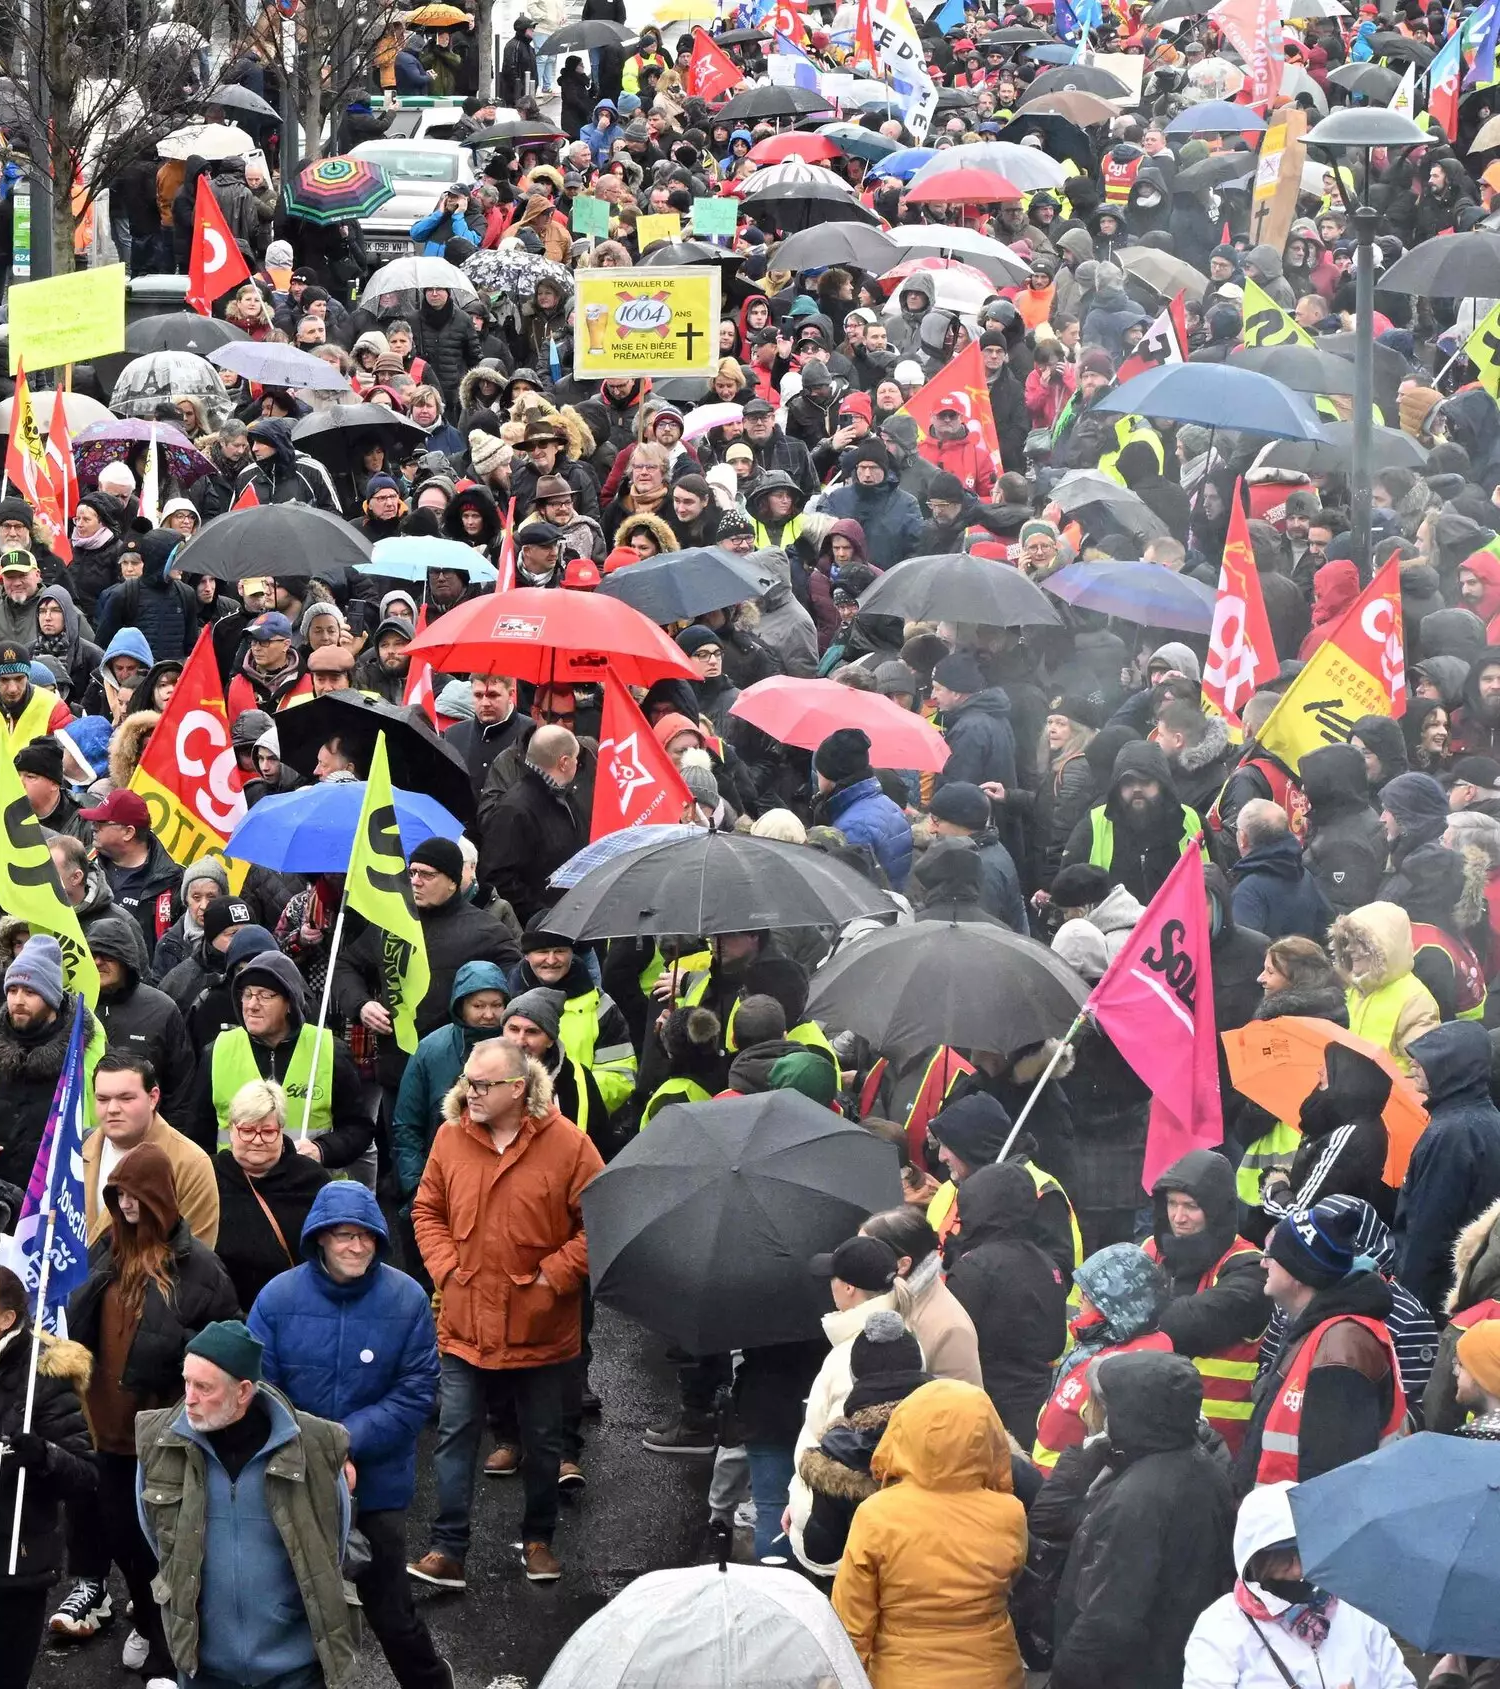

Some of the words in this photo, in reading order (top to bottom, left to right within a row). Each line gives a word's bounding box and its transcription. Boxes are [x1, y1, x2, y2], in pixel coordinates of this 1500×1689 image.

[612, 280, 661, 288] TRAVAILLER
[618, 303, 665, 322] 1664
[650, 341, 677, 350] BIÈRE
[613, 351, 675, 360] PRÉMATURÉE
[175, 709, 250, 833] cg
